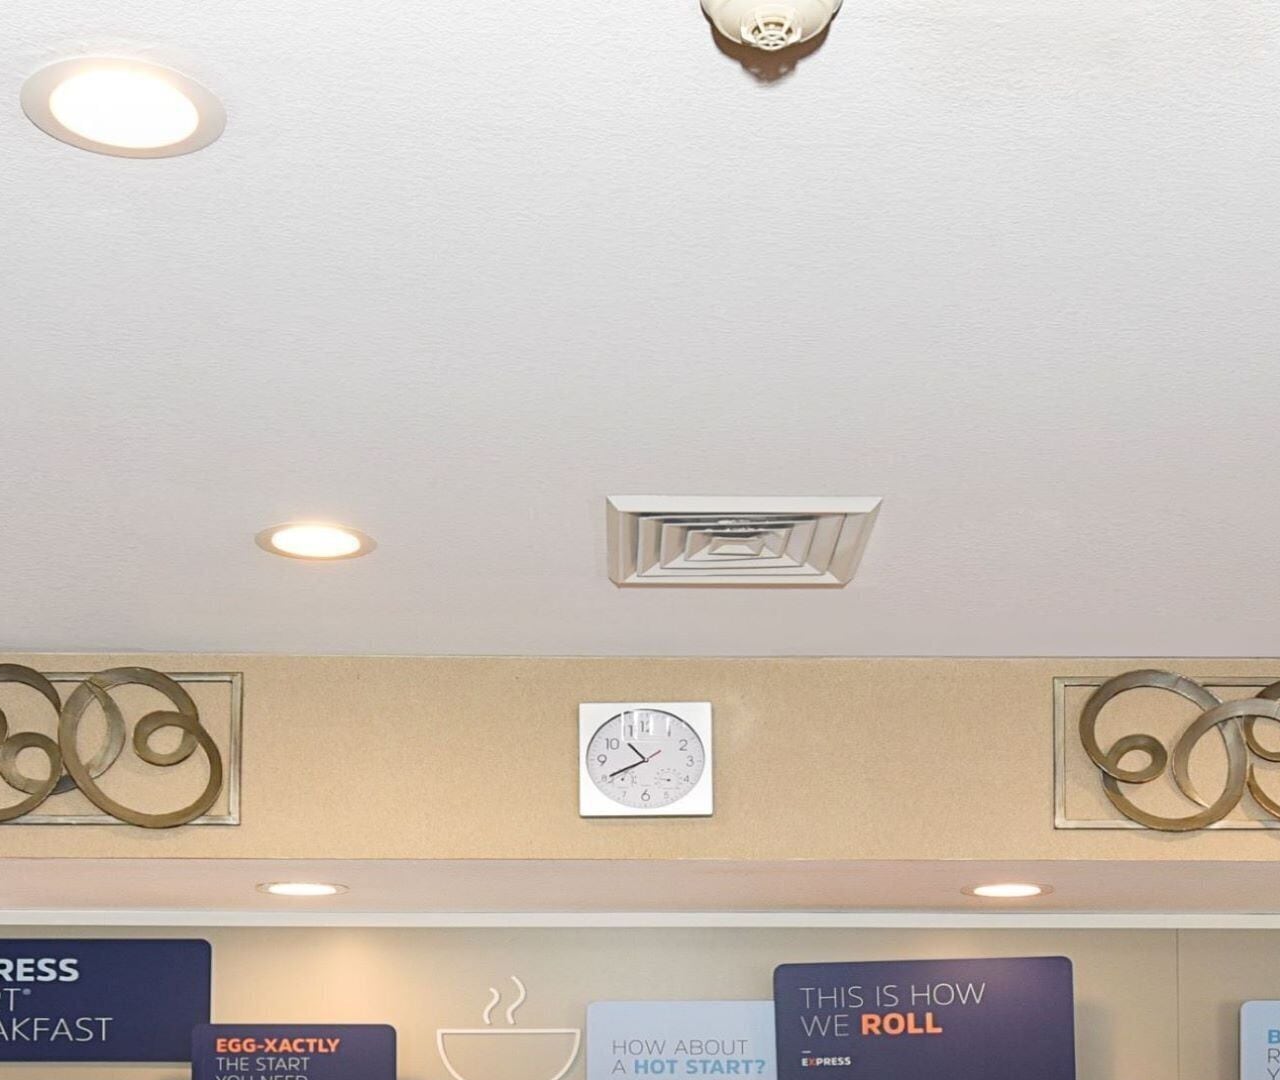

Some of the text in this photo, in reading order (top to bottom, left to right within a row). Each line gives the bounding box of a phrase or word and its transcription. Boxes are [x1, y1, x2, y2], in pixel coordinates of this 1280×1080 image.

[605, 737, 620, 751] 10
[679, 739, 689, 751] 2
[597, 754, 608, 766] 9
[686, 755, 695, 767] 3
[640, 788, 651, 801] 6
[800, 982, 986, 1009] THIS IS HOW
[800, 1012, 943, 1037] WE ROLL
[216, 1038, 340, 1053] EGG-XACTLY
[612, 1039, 748, 1056] HOW ABOUT
[216, 1057, 310, 1072] THE START
[611, 1059, 766, 1075] A HOT START?
[801, 1057, 852, 1067] EXPRESS
